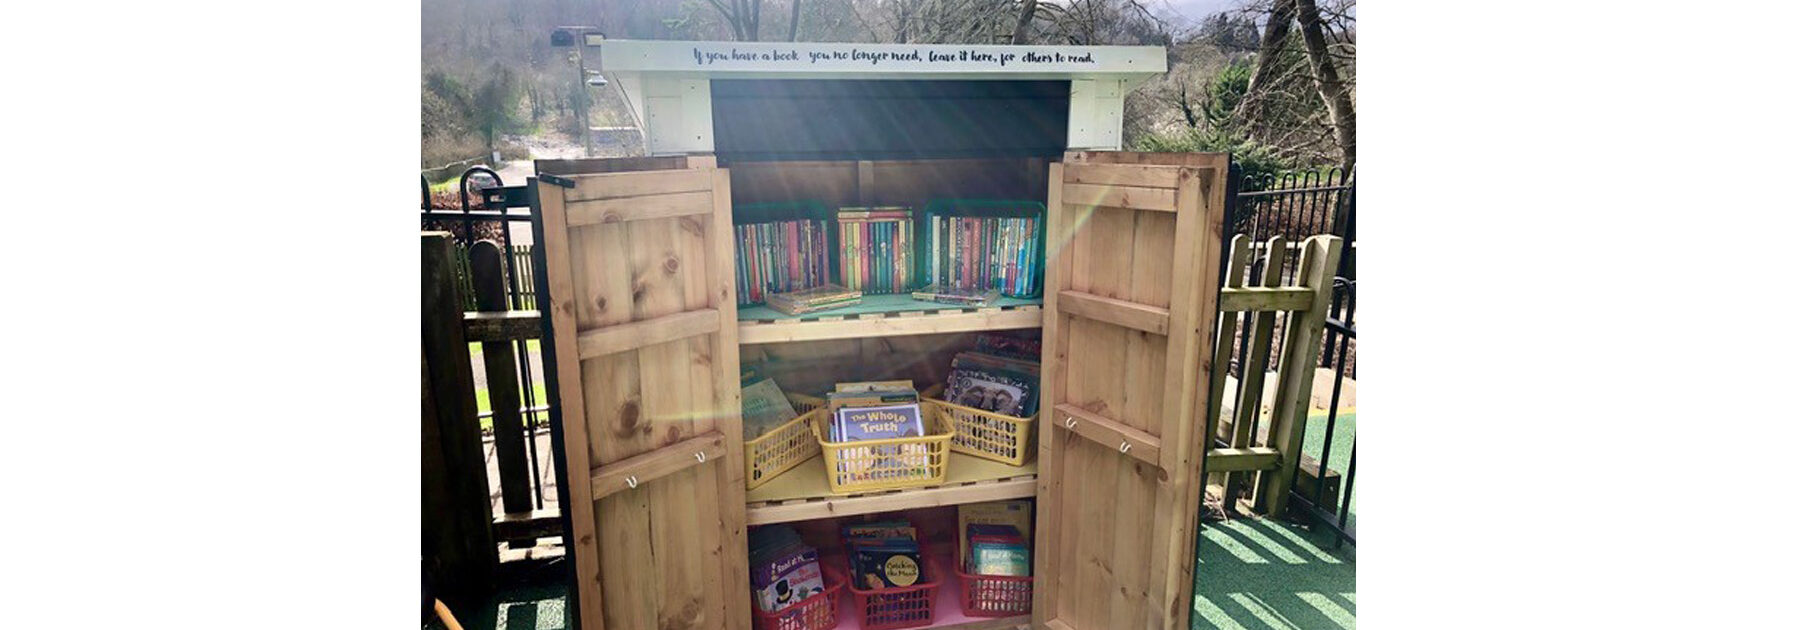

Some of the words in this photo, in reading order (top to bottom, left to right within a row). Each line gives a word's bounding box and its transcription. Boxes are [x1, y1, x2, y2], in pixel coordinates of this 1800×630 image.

[693, 47, 702, 65] If
[706, 52, 728, 64] you
[731, 48, 757, 61] have
[762, 53, 770, 61] a
[773, 49, 799, 61] book
[809, 51, 830, 63] you
[833, 51, 848, 60] no
[852, 48, 888, 65] longer
[891, 49, 922, 62] need,
[929, 50, 955, 62] leave
[959, 50, 967, 62] it
[971, 50, 998, 62] here,
[1000, 53, 1015, 66] for
[1022, 52, 1053, 63] others
[1055, 52, 1066, 63] to
[860, 421, 898, 433] Truth
